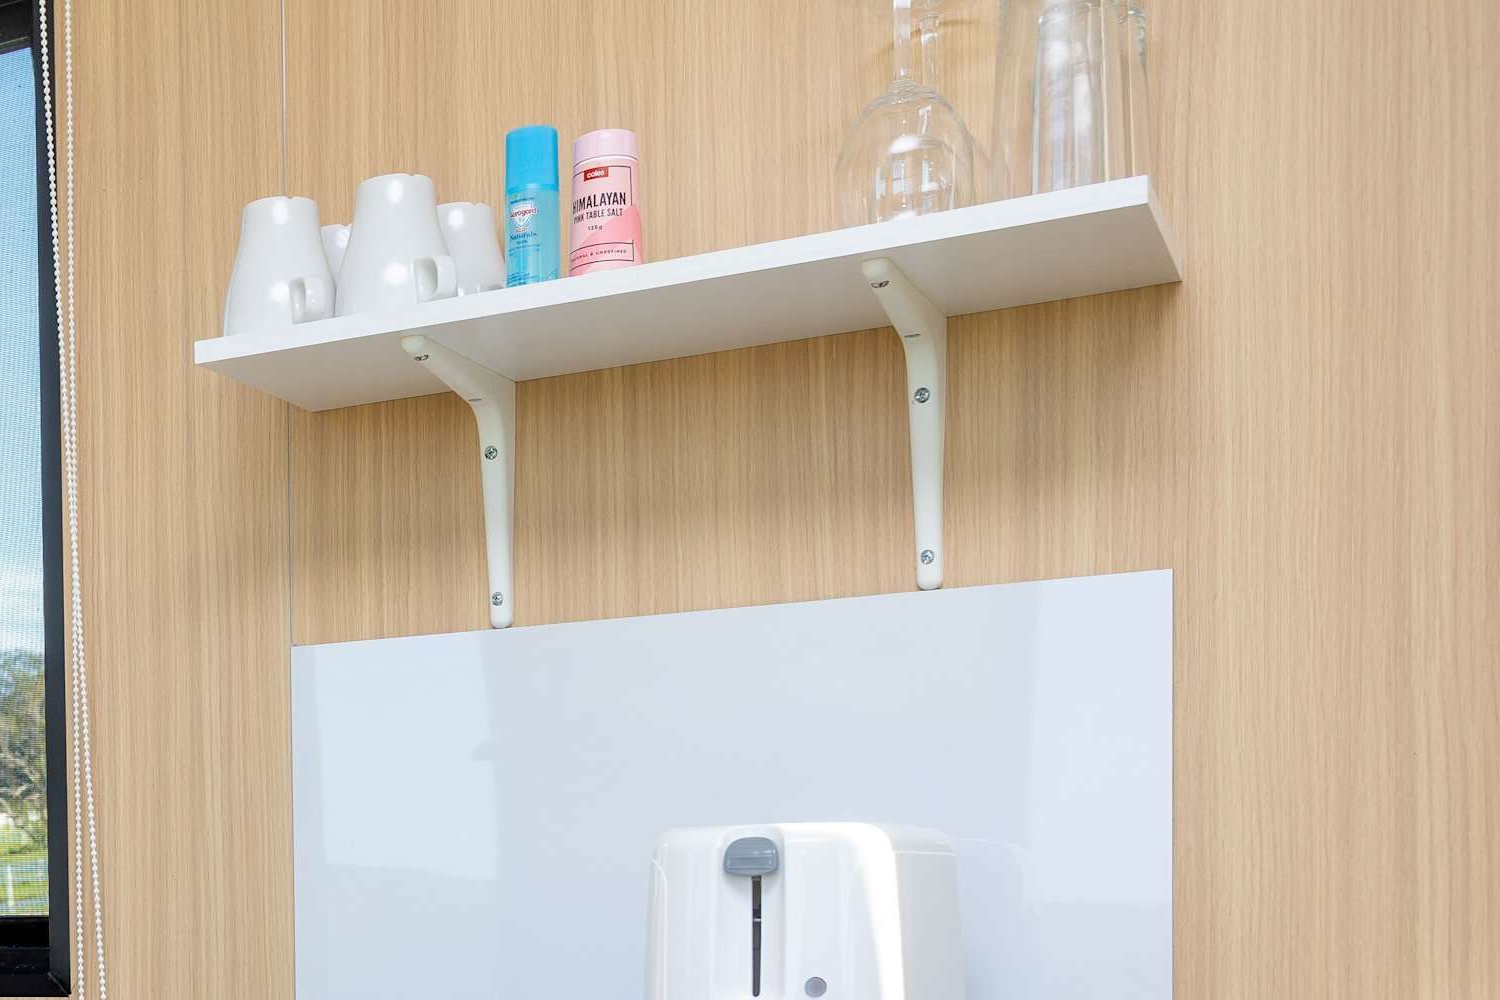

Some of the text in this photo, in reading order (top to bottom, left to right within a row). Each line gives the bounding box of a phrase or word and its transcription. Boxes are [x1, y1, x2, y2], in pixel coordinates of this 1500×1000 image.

[572, 191, 627, 215] HIMALAYAN
[574, 208, 623, 225] PINK TABLE SALT
